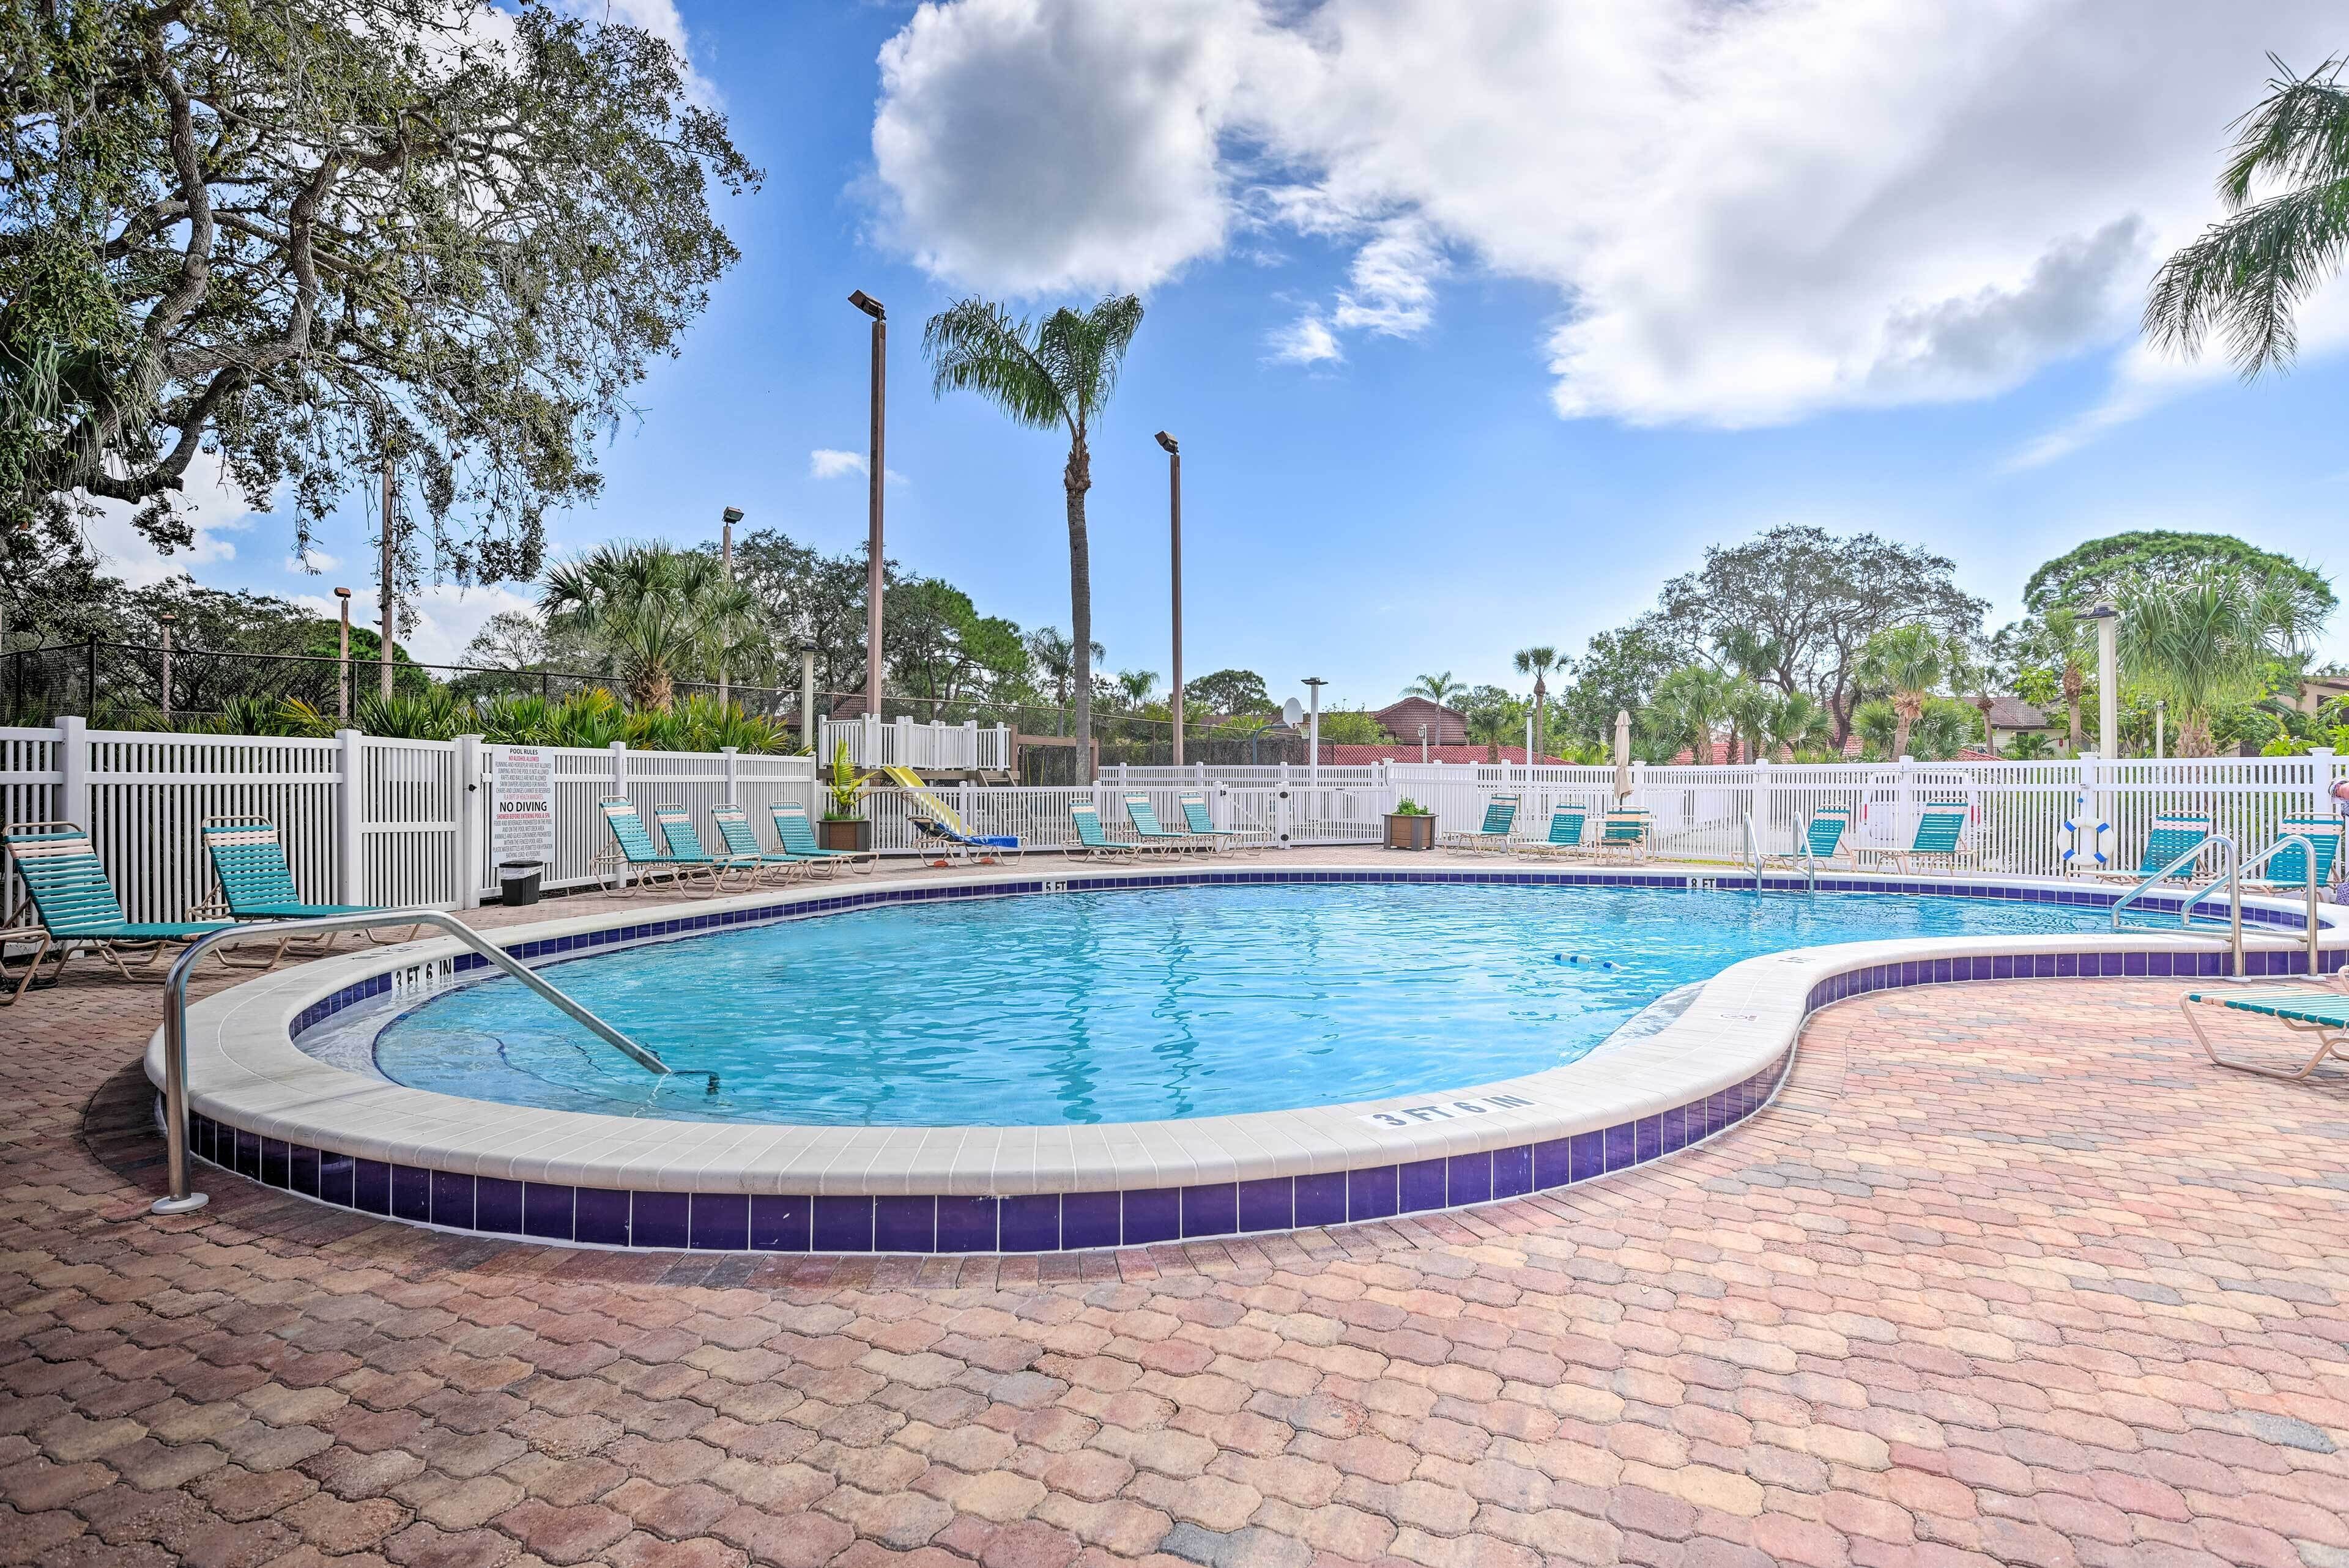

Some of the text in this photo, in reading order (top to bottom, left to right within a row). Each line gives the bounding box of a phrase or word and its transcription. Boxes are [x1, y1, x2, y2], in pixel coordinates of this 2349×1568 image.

[500, 802, 547, 812] NO DIVING
[1046, 881, 1066, 892] 5 FT
[1691, 878, 1715, 887] 8 FT
[396, 958, 451, 987] 3 FT 6 IN
[1373, 1095, 1535, 1125] 3 FT 6 IN
